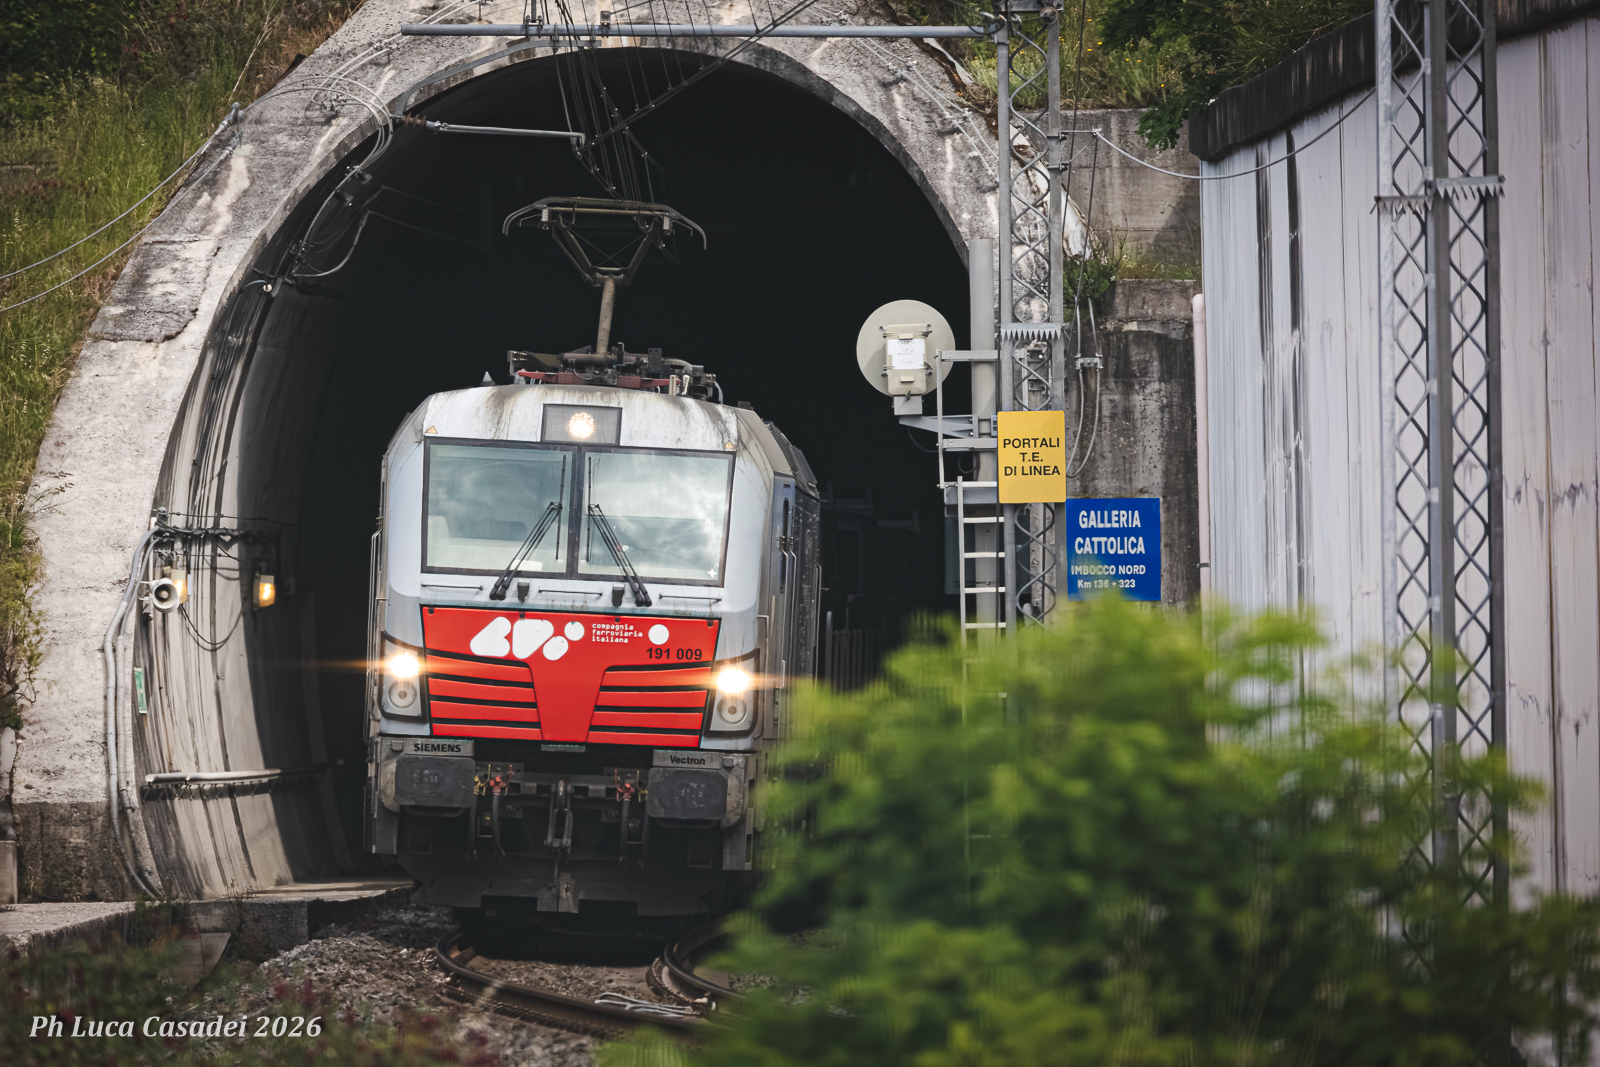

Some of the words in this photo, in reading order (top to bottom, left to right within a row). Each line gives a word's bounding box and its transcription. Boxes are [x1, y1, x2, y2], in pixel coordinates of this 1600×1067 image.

[1003, 437, 1060, 449] PORTALI
[1020, 452, 1043, 462] T.E.
[1004, 466, 1017, 476] DI
[1021, 465, 1061, 476] LINEA
[1078, 510, 1141, 529] GALLERIA
[1074, 536, 1146, 555] CATTOLICA
[1070, 564, 1116, 575] IMBOCCO
[1118, 564, 1146, 575] NORD
[1077, 579, 1092, 588] Km
[1118, 579, 1136, 588] 323
[592, 623, 634, 631] compagnia
[592, 629, 643, 638] ferroviaria
[592, 635, 629, 643] italiana
[646, 647, 671, 660] 191
[676, 648, 703, 661] 009
[414, 743, 462, 752] SIEMENS
[669, 755, 706, 765] Vectron
